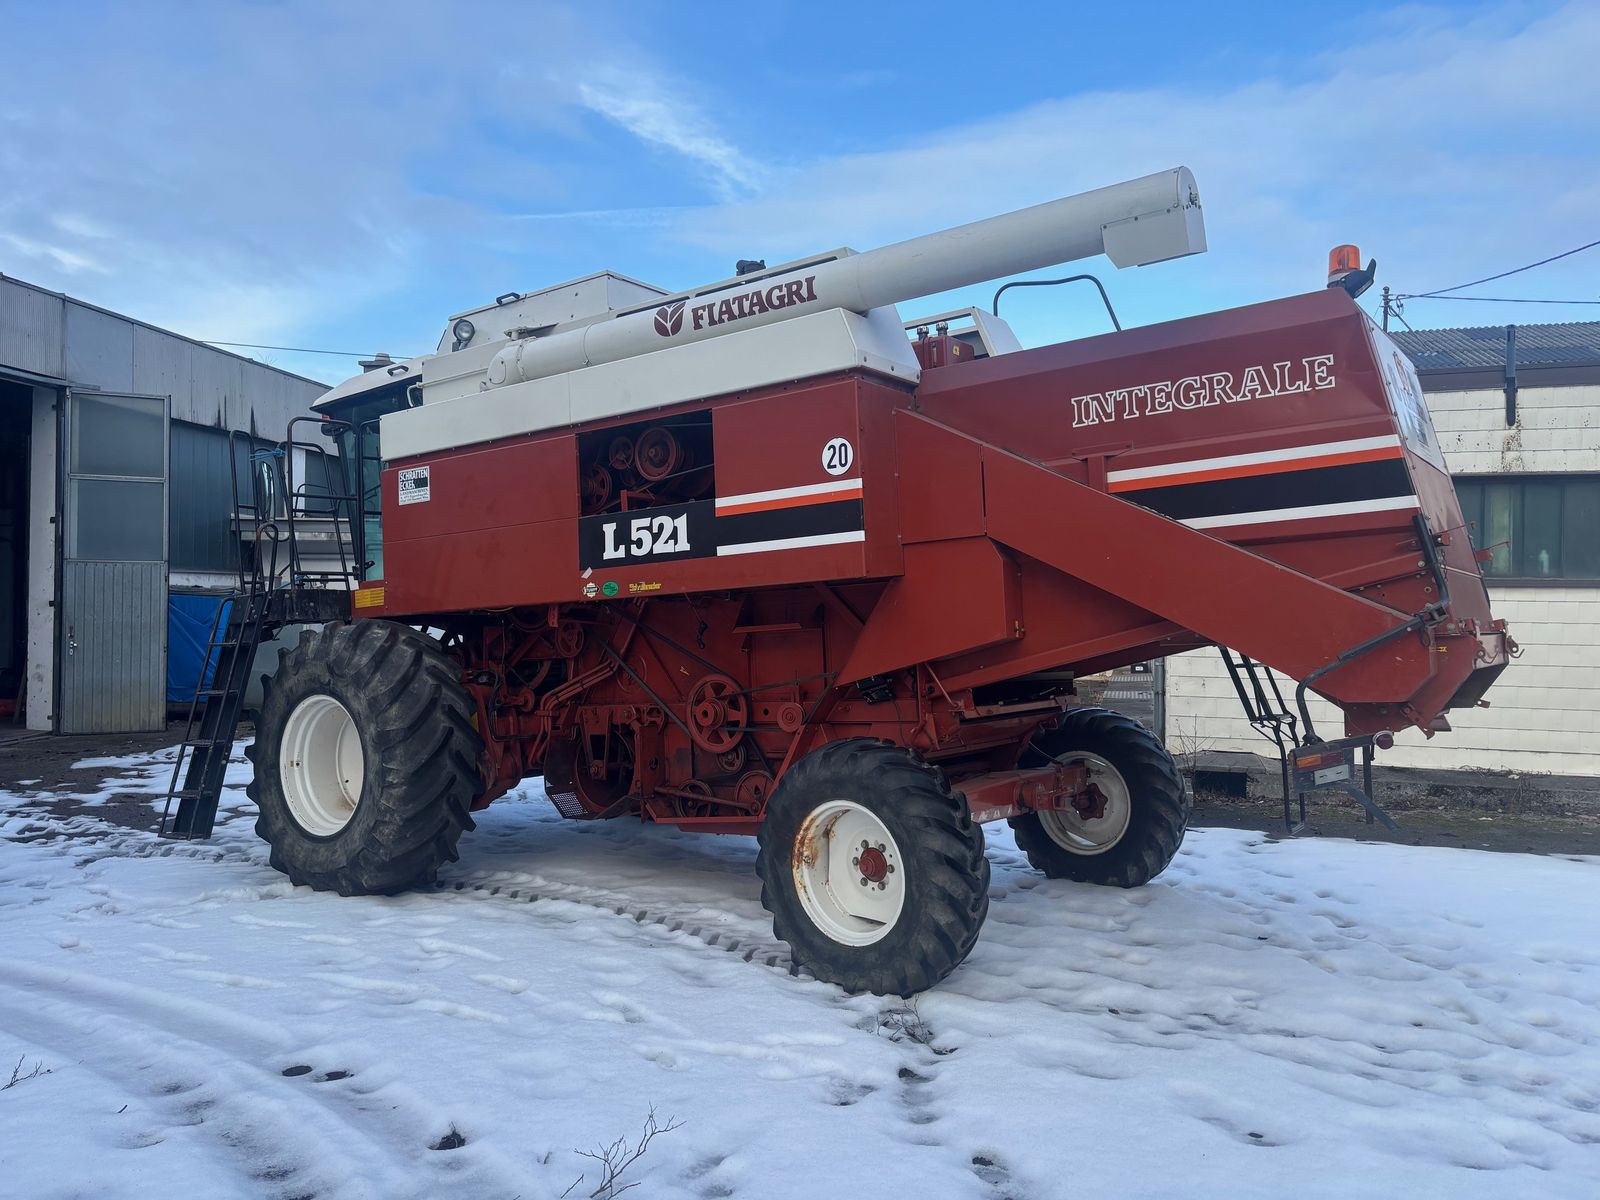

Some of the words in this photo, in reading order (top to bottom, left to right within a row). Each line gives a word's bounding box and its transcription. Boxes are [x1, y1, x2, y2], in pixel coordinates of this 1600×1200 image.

[691, 276, 817, 331] FIATAGRI
[1071, 353, 1336, 428] INTEGRALE
[400, 469, 428, 481] SCHRATTEN
[827, 443, 848, 469] 20
[603, 522, 625, 560] L
[630, 512, 690, 557] 521
